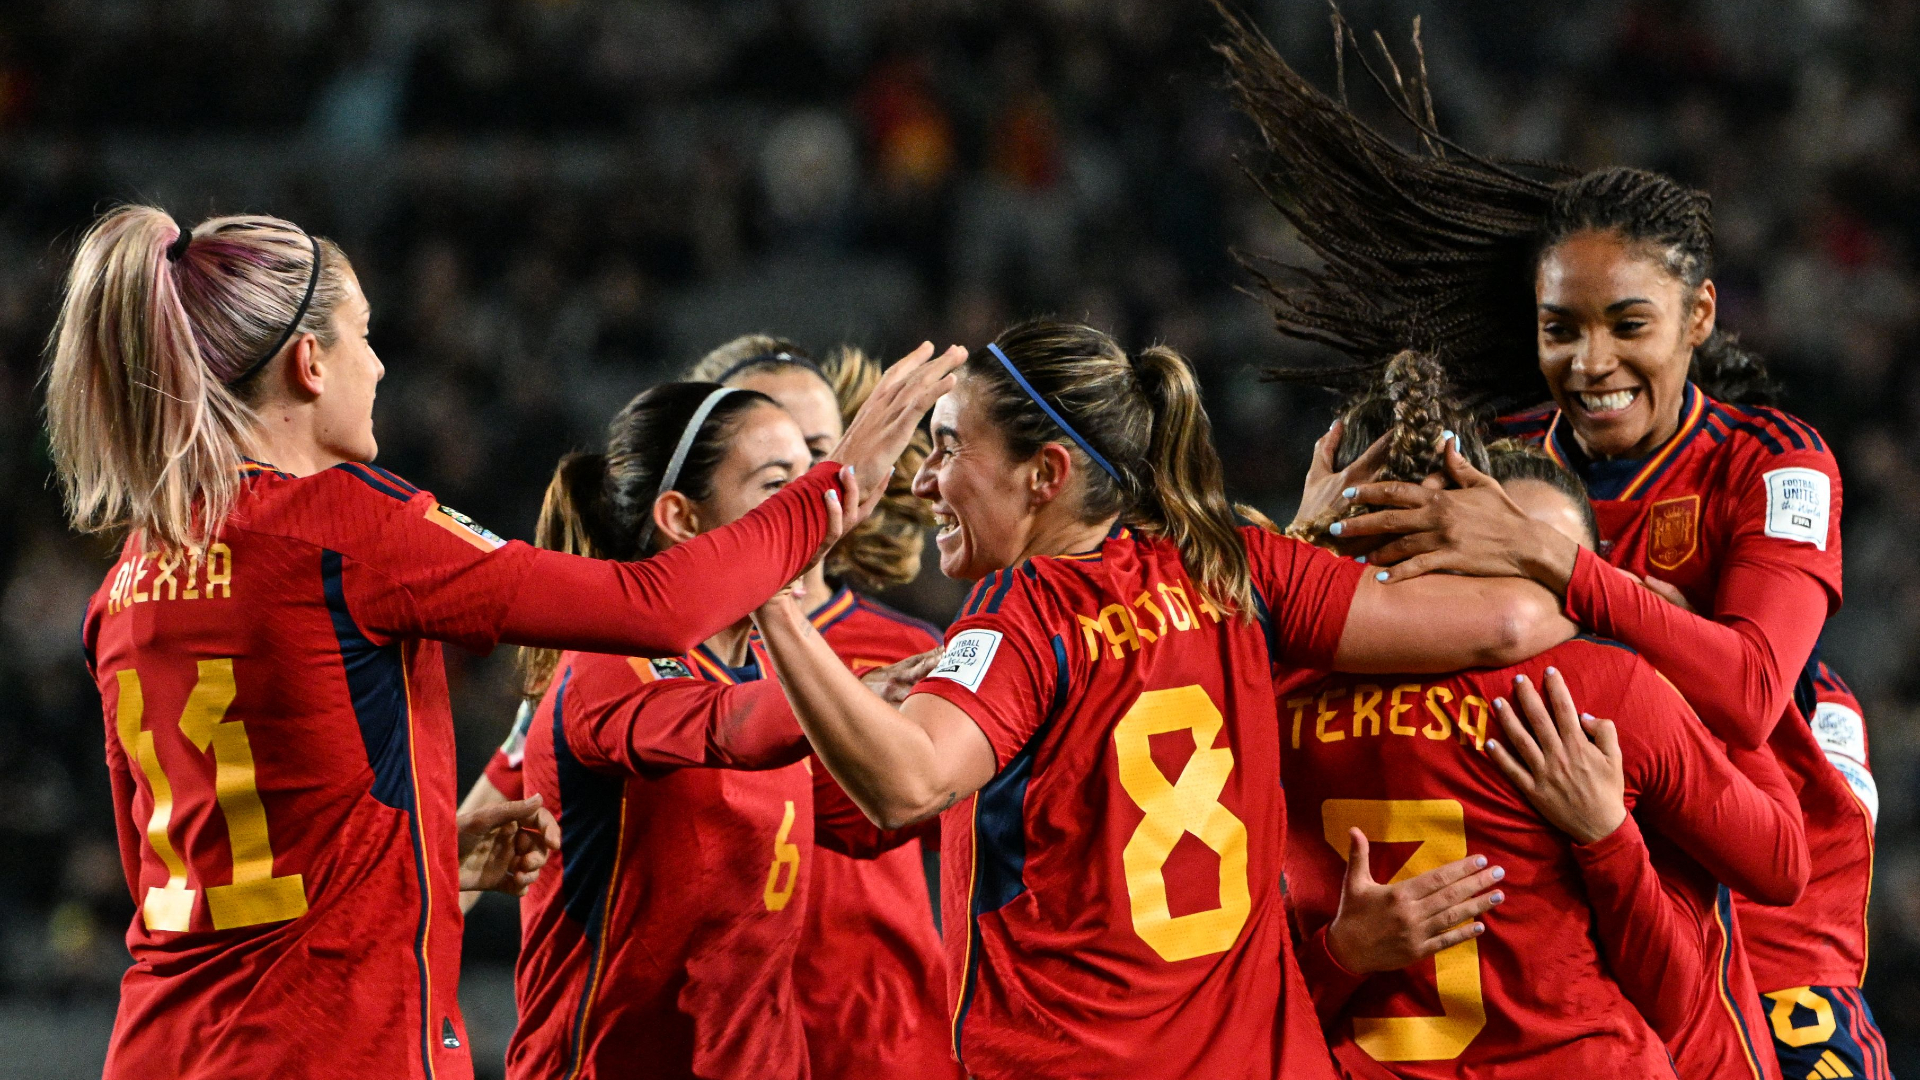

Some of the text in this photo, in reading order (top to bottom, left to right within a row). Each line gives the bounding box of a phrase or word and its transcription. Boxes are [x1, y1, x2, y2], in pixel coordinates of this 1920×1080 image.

[1783, 487, 1820, 506] UNITES
[108, 543, 232, 615] ALEXIA
[1286, 683, 1489, 751] TERESA
[116, 658, 309, 932] 11
[1113, 684, 1252, 962] 8
[763, 800, 800, 911] 6
[1321, 799, 1487, 1062] 3
